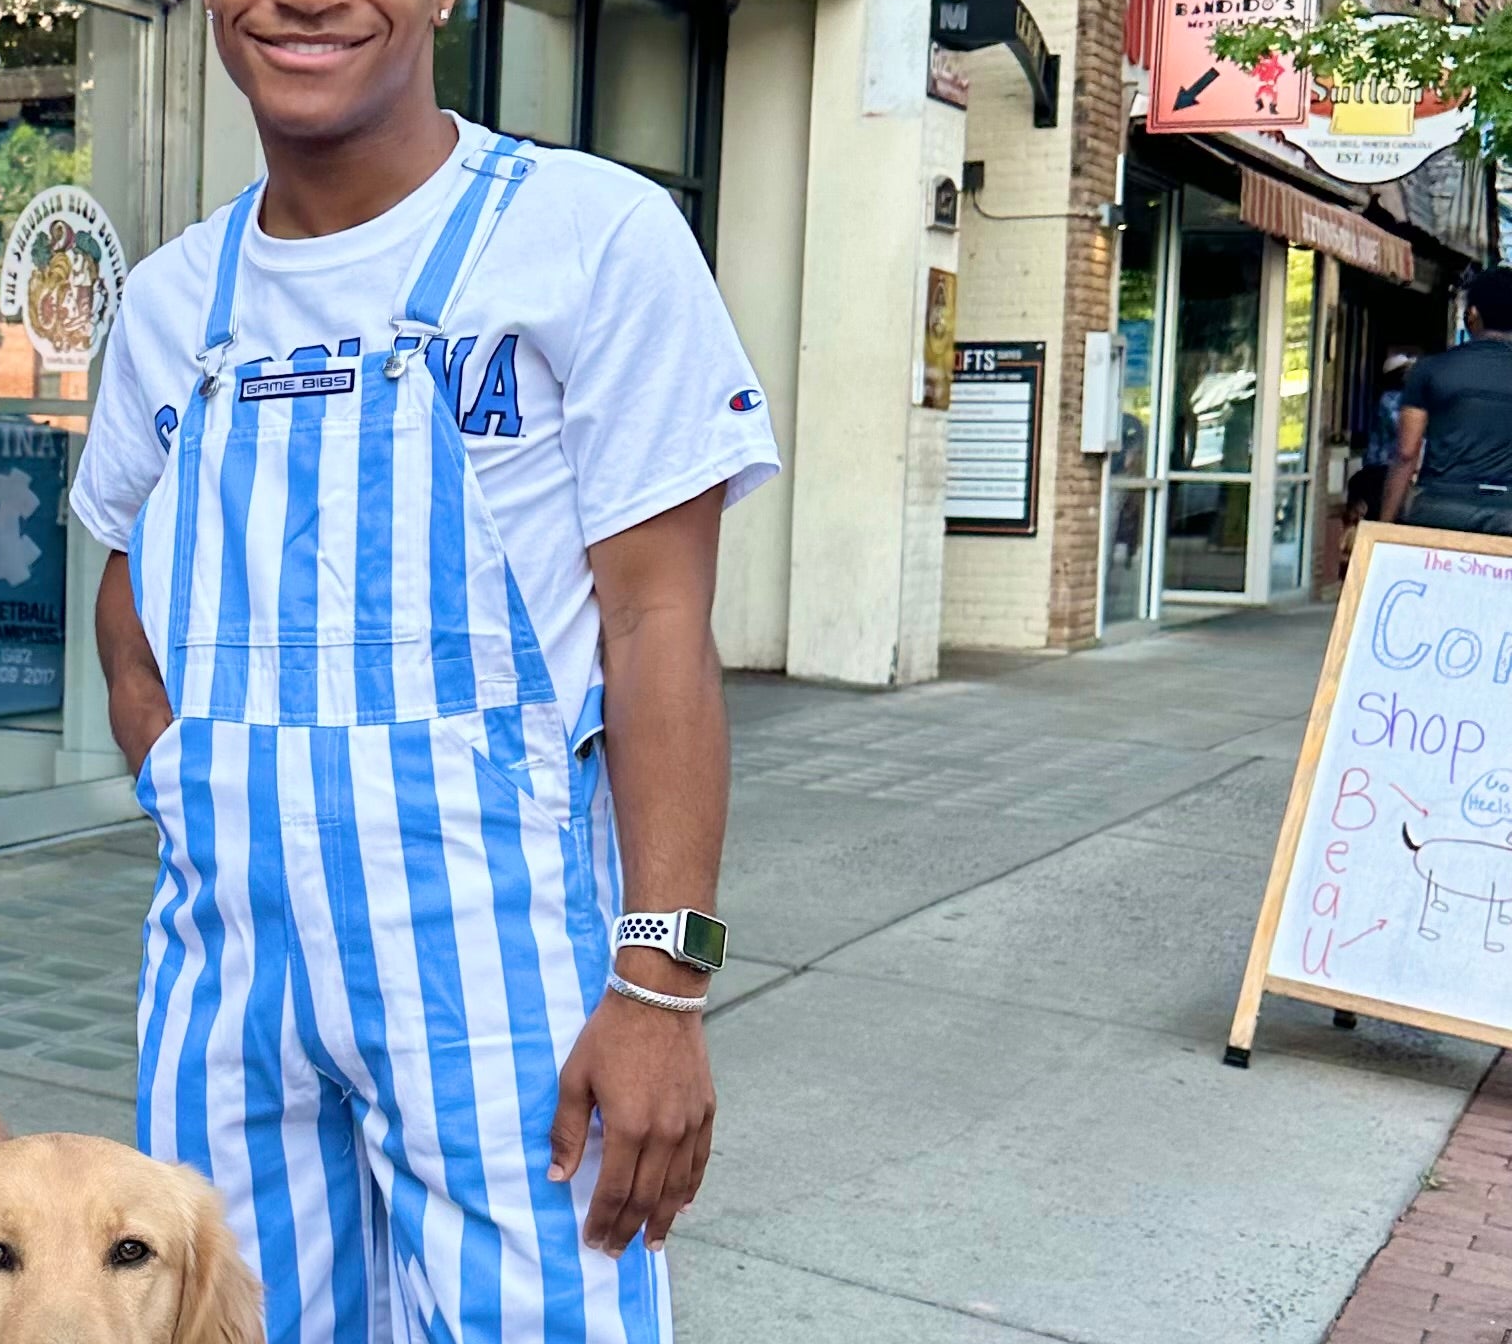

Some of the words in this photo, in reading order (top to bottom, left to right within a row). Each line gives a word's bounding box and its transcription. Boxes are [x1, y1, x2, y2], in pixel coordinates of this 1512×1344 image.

[1336, 152, 1364, 164] EST.
[245, 378, 296, 396] GAME
[302, 374, 349, 389] BIBS
[1424, 551, 1452, 573] The
[1352, 691, 1485, 784] Shop
